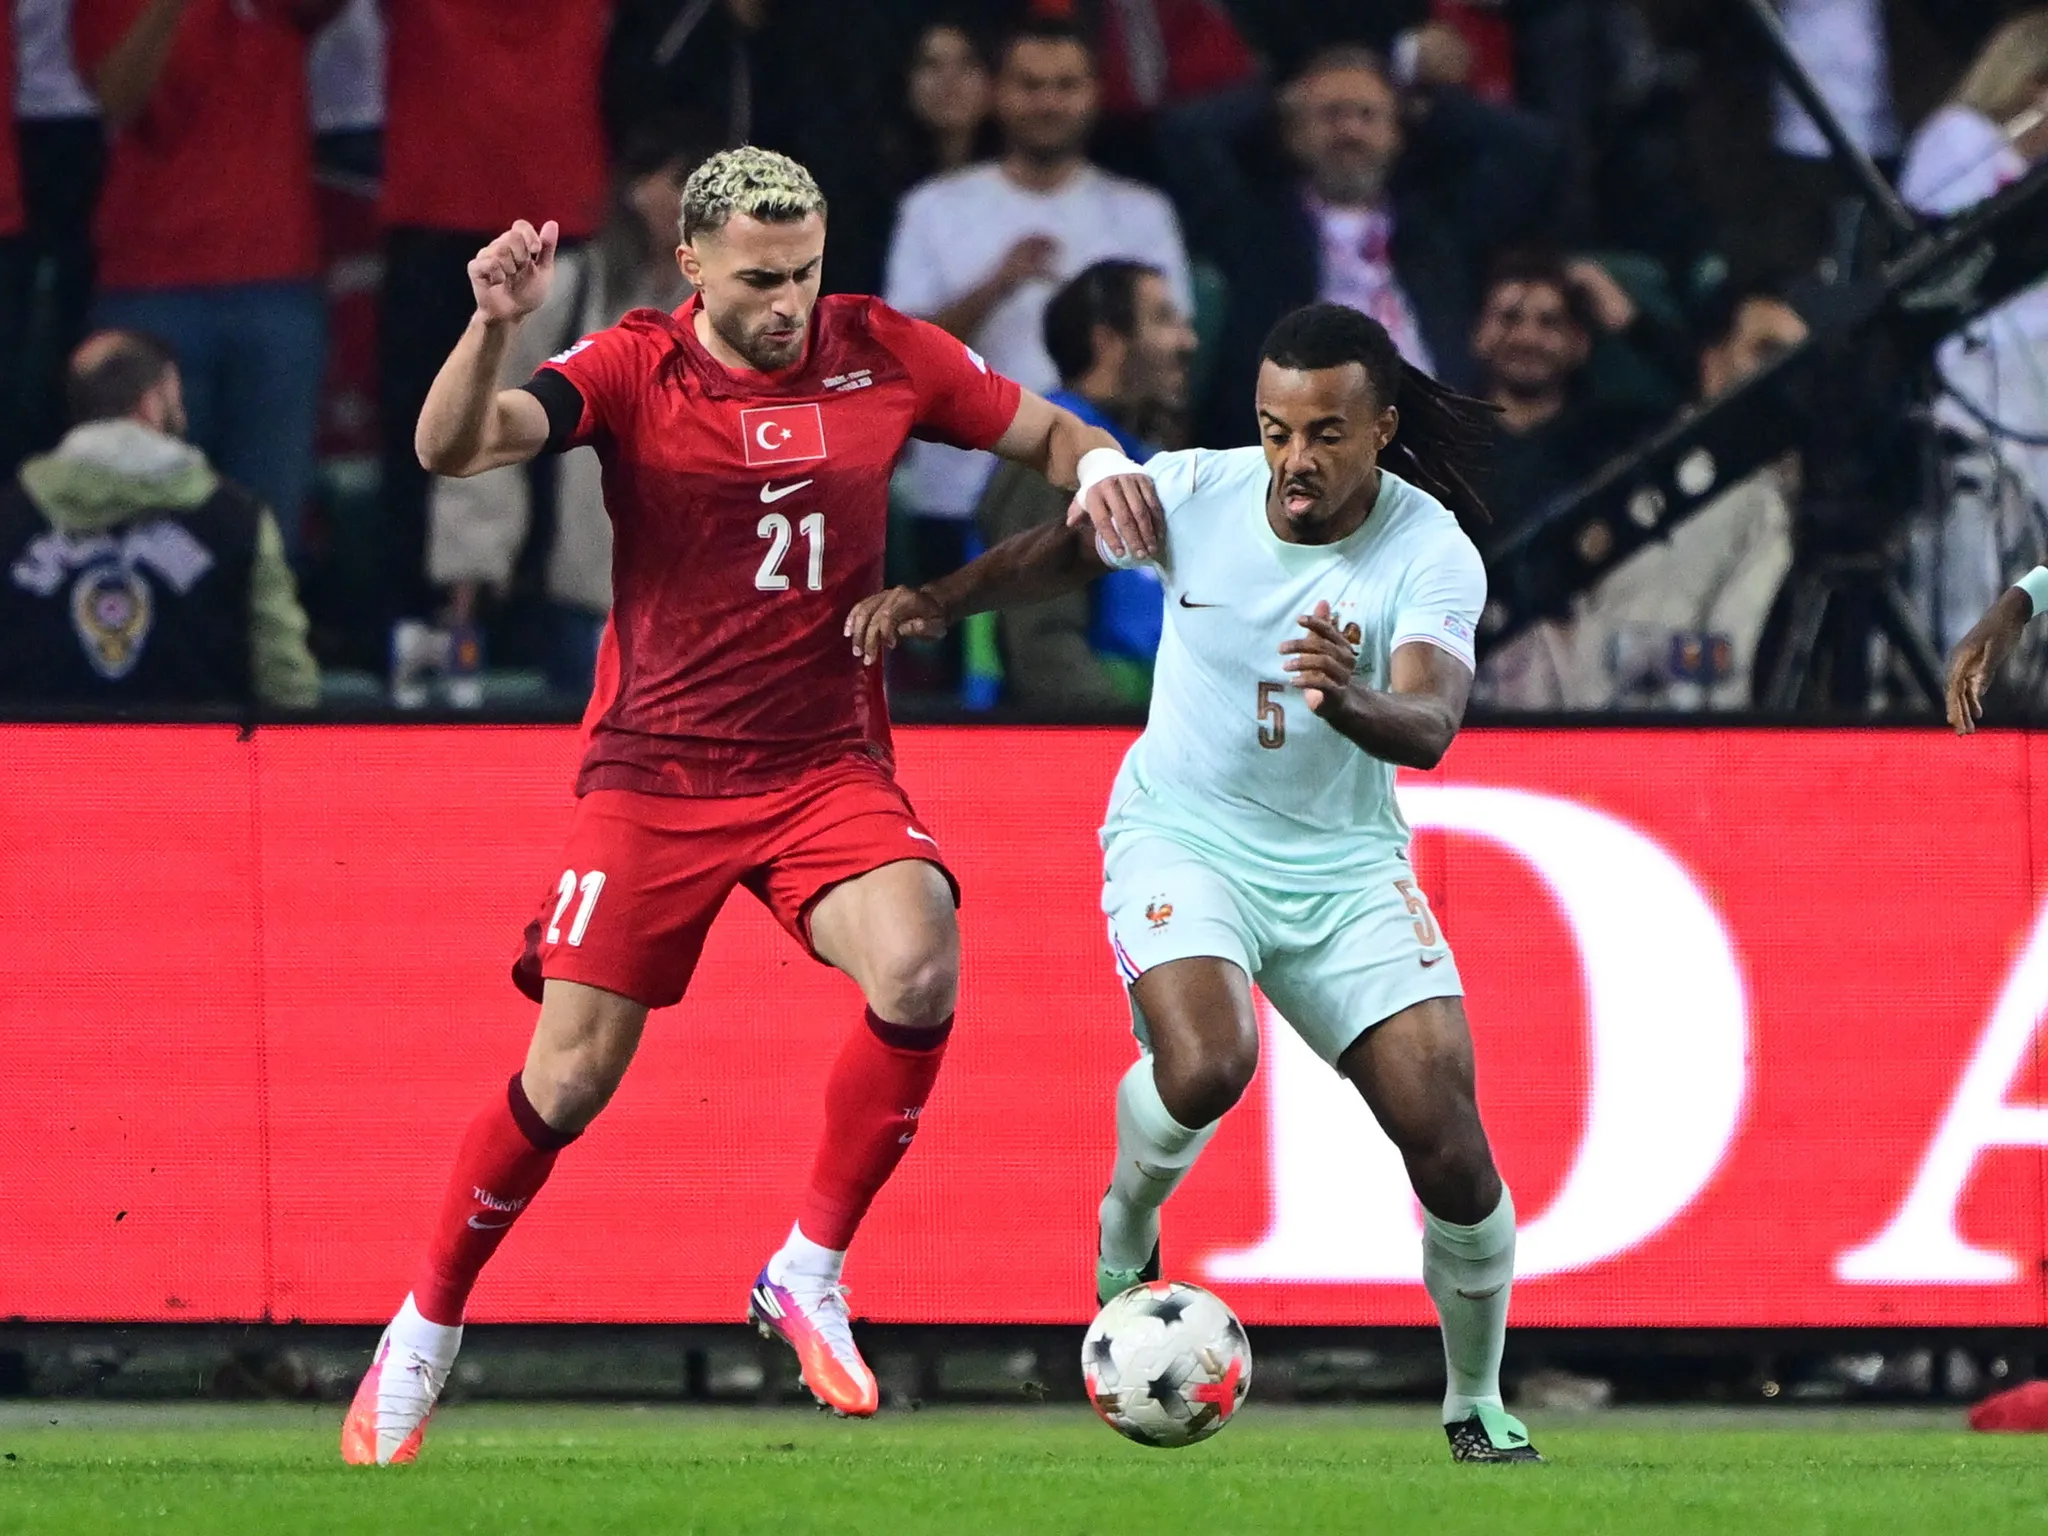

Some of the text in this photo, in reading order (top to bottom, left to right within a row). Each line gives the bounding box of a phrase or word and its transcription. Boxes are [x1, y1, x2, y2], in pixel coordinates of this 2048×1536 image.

[755, 512, 825, 591] 21
[1258, 681, 1285, 749] 5
[545, 868, 607, 947] 21
[1393, 879, 1437, 947] 5
